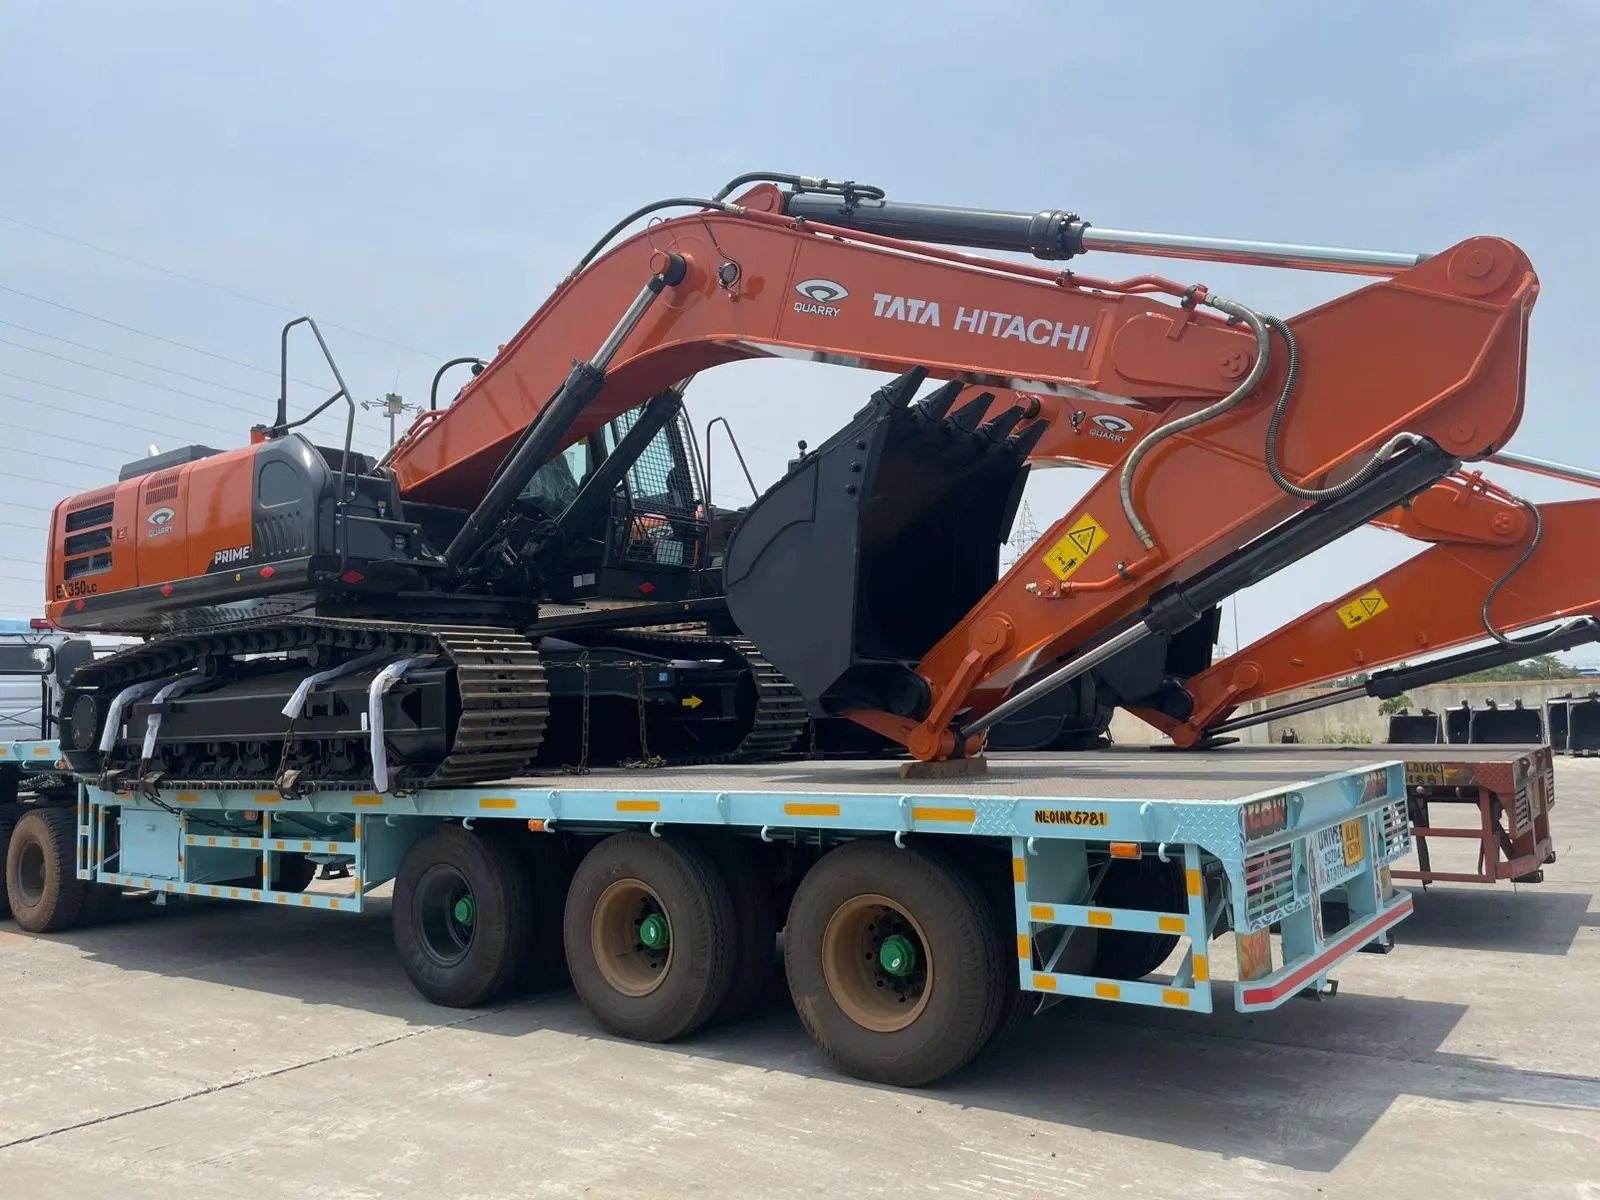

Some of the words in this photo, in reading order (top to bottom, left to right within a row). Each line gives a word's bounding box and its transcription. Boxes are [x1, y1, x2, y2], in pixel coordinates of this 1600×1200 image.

[794, 302, 840, 317] QUARRY
[872, 293, 940, 327] TATA
[953, 306, 1090, 352] HITACHI
[1089, 429, 1127, 444] QUARRY
[148, 527, 172, 538] QUARRY
[214, 545, 250, 565] PRIME
[1074, 811, 1105, 826] 5781
